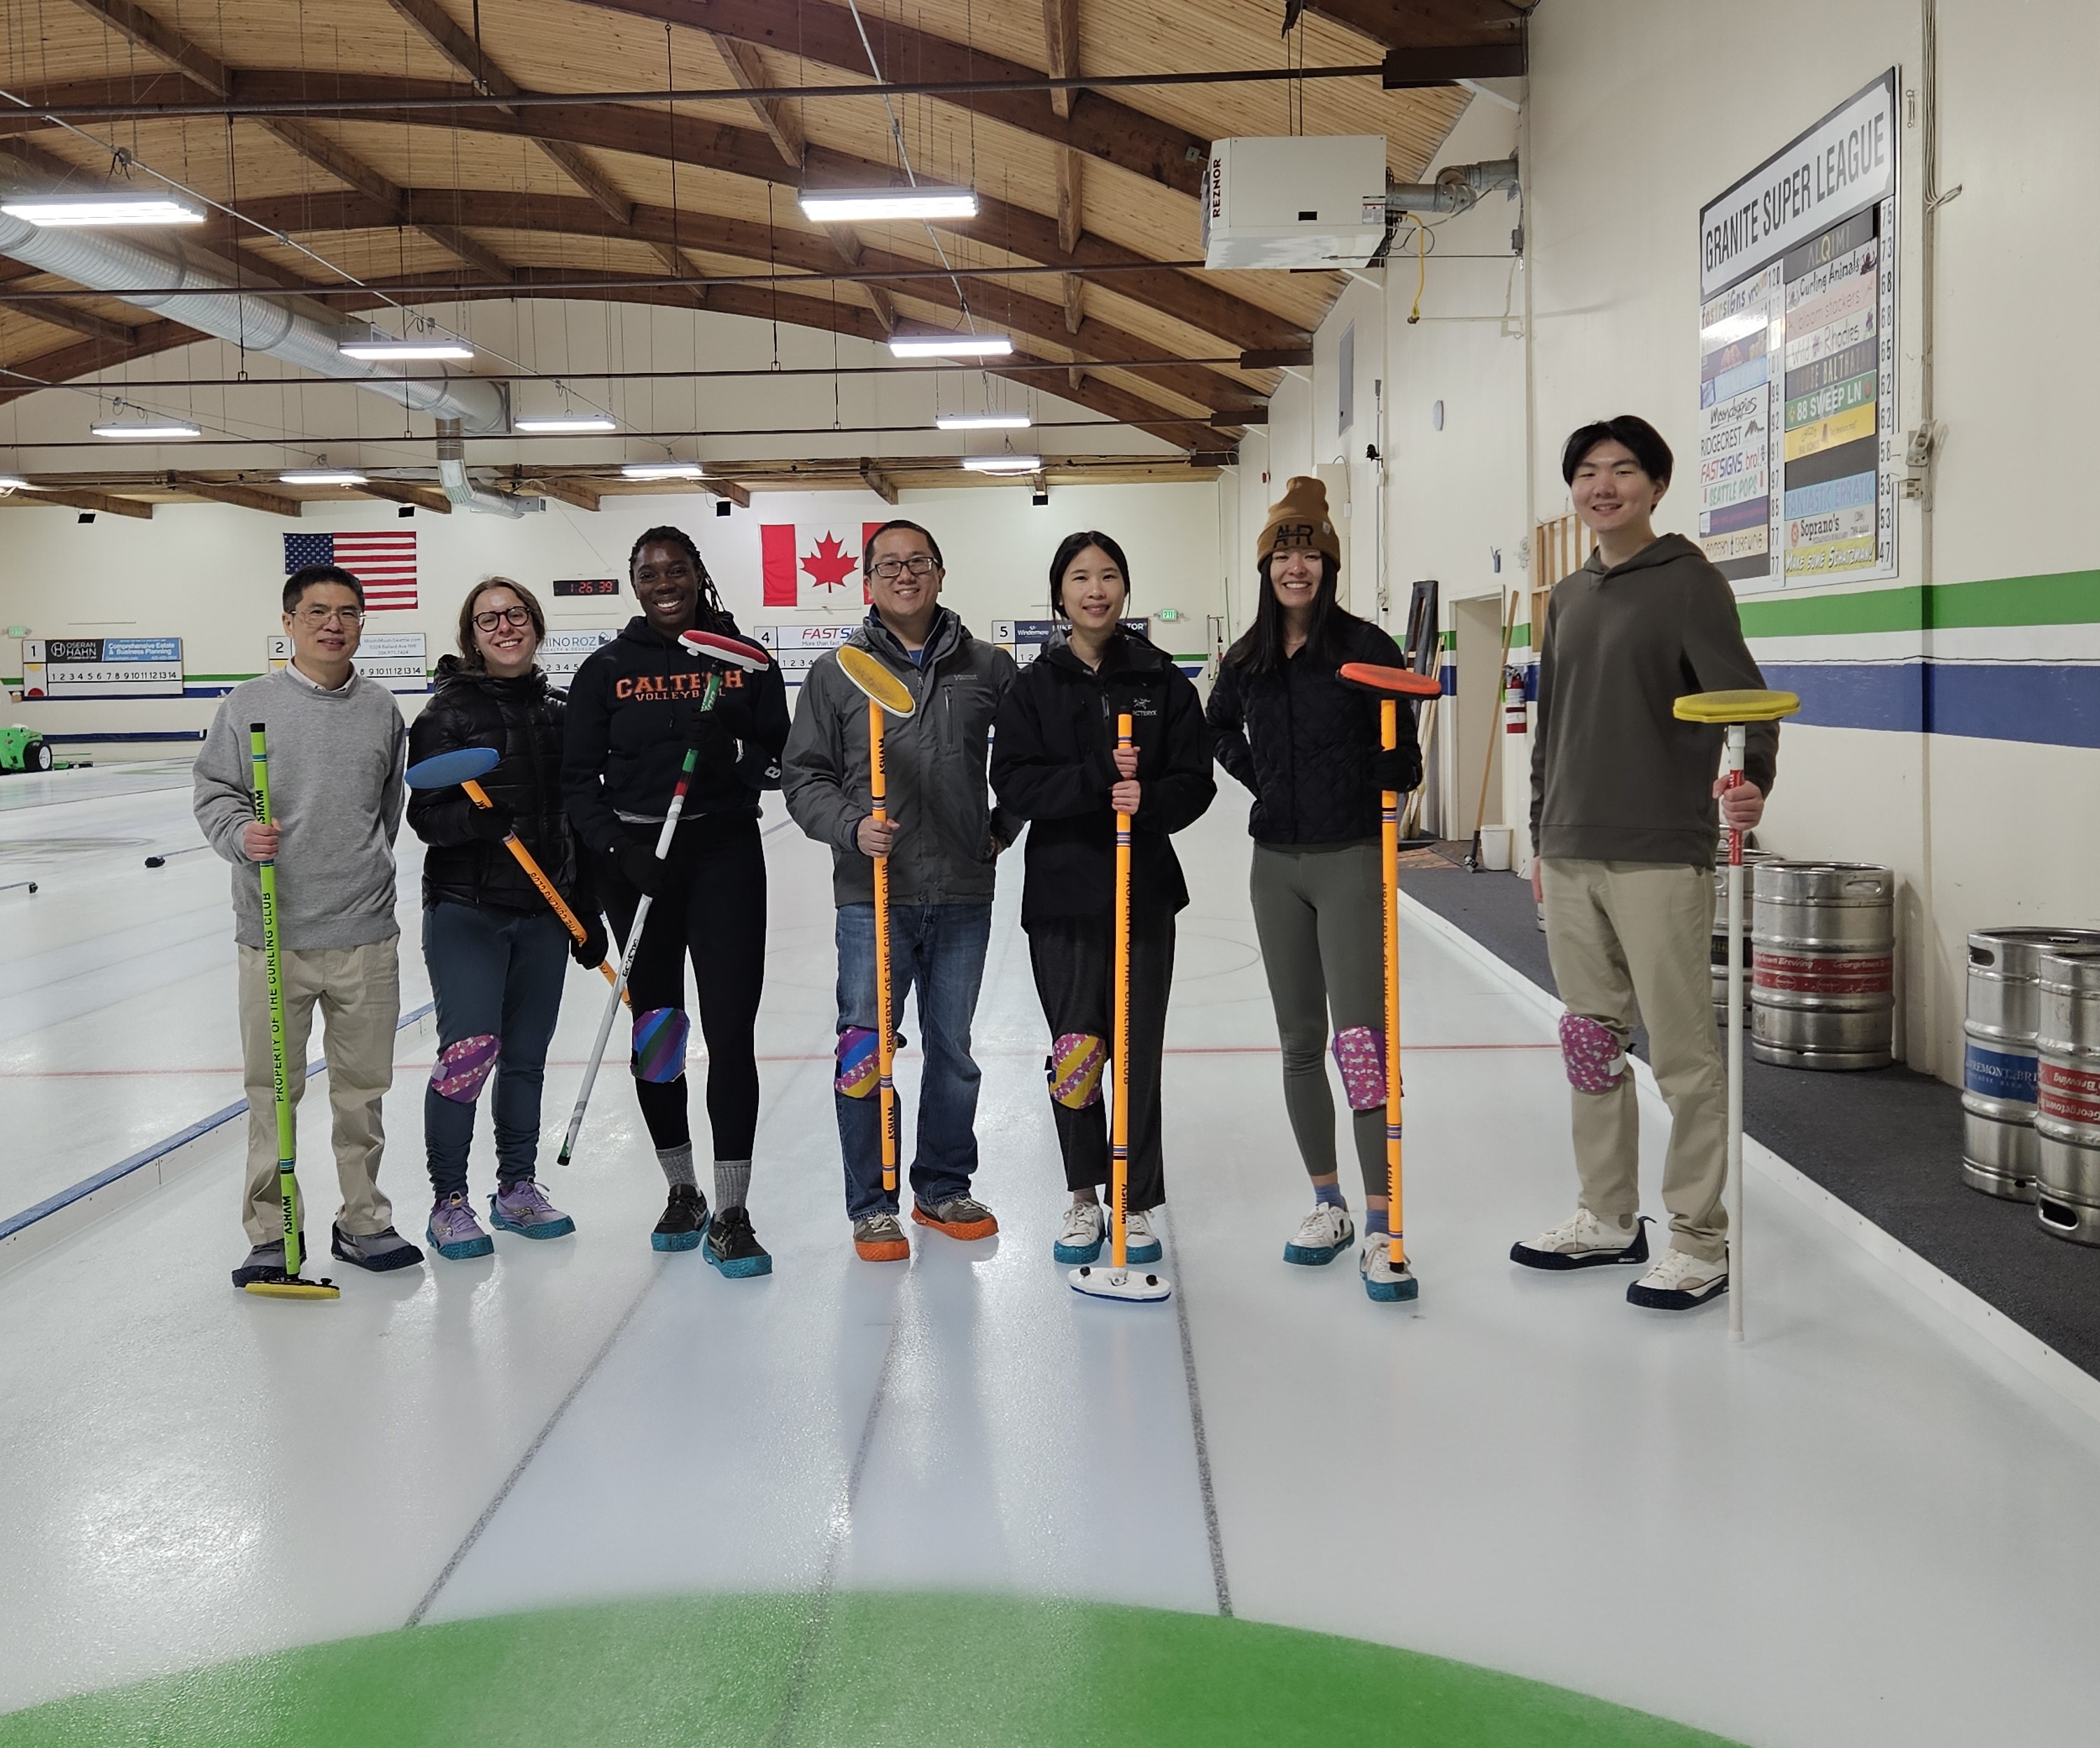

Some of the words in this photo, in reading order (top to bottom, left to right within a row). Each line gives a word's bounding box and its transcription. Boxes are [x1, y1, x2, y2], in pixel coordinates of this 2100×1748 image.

[1212, 158, 1221, 218] REZNOR
[1705, 199, 1758, 273] GRANITE
[1763, 163, 1811, 237] SUPER
[1817, 111, 1884, 203] LEAGUE
[1807, 225, 1850, 270] ALQIMI
[1882, 239, 1892, 262] 73
[1769, 266, 1780, 288] 120
[1800, 272, 1827, 297] Curling
[1829, 250, 1859, 284] Animals
[1882, 272, 1891, 295] 68
[1882, 305, 1891, 327] 68
[1881, 340, 1891, 363] 65
[1768, 354, 1779, 375] 101
[1772, 385, 1779, 403] 99
[1881, 374, 1891, 395] 62
[1797, 400, 1808, 421] 88
[1810, 387, 1845, 418] SWEEP
[1847, 380, 1862, 405] LN
[1772, 412, 1779, 432] 92
[1881, 407, 1891, 429] 62
[1701, 426, 1742, 458] RIDGECREST
[1772, 440, 1779, 460] 91
[1881, 442, 1891, 463] 58
[1746, 451, 1760, 472] bro!
[1709, 481, 1737, 507] SEATTLE
[1880, 475, 1891, 496] 53
[1772, 498, 1779, 517] 85
[1786, 484, 1830, 518] FANTASTIC
[1800, 513, 1840, 540] Soprano's
[1880, 507, 1891, 529] 53
[1772, 527, 1779, 545] 77
[1879, 541, 1890, 564] 47
[1772, 557, 1779, 575] 77
[761, 632, 770, 643] 4
[1000, 626, 1009, 637] 5
[31, 645, 36, 657] 1
[66, 648, 97, 657] HAHN
[276, 642, 284, 653] 2
[615, 669, 744, 699] CALTEH
[255, 790, 265, 825] SHAM
[530, 872, 546, 892] CLUB
[263, 893, 272, 925] CLUB
[545, 890, 567, 919] CURLING
[564, 919, 578, 933] THE
[883, 899, 891, 947] CURLING
[265, 930, 277, 984] CURLING
[1779, 958, 1813, 970] Brewing
[884, 977, 892, 991] OF
[270, 988, 278, 1010] THE
[271, 1017, 279, 1033] OF
[885, 995, 893, 1053] PROPERTY
[272, 1038, 284, 1102] PROPERTY
[2053, 1072, 2096, 1092] Brewing
[2045, 1100, 2100, 1121] Georgetown
[887, 1106, 895, 1140] ASHAM
[282, 1195, 293, 1234] ASHAM
